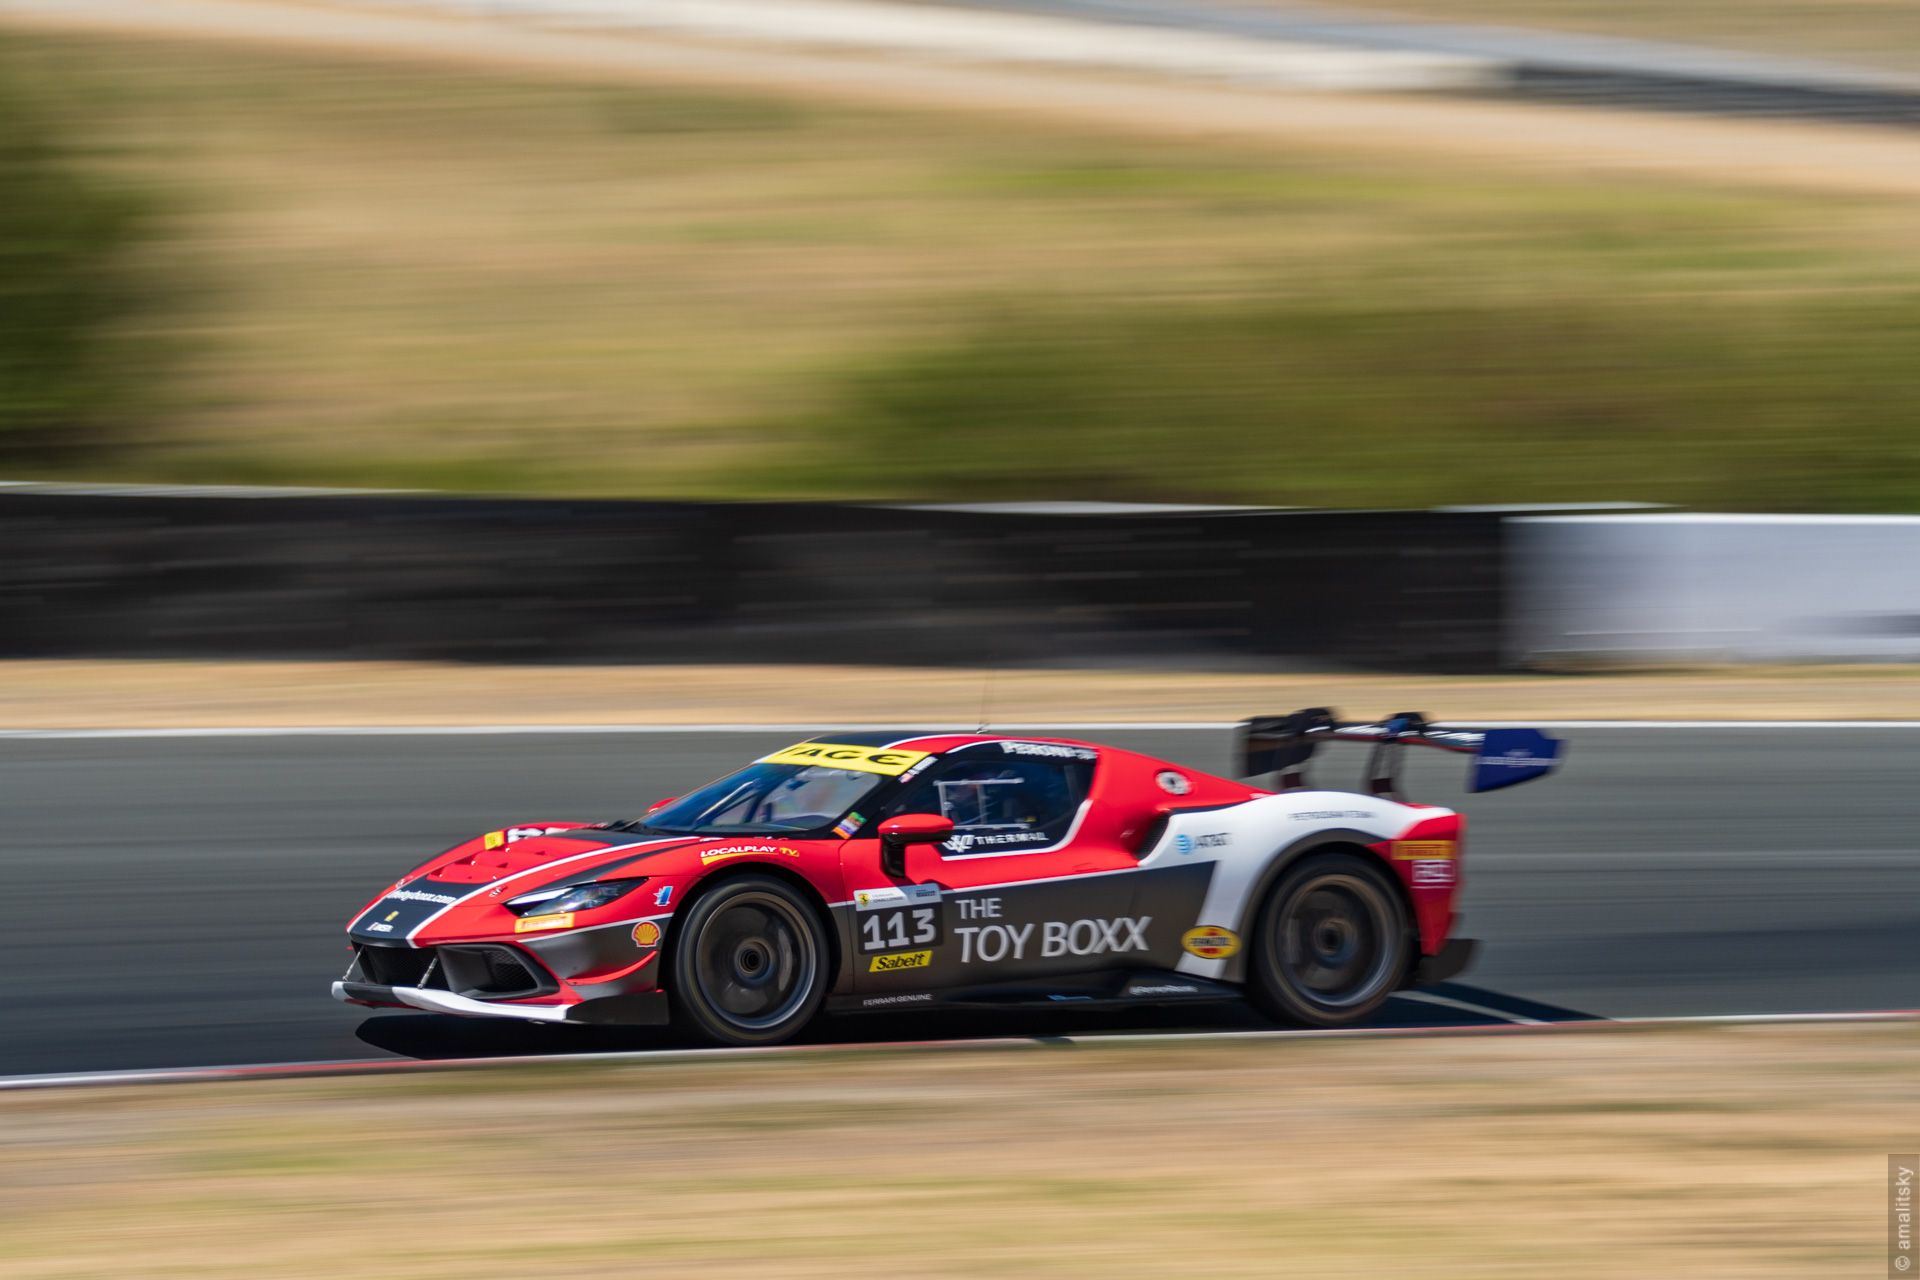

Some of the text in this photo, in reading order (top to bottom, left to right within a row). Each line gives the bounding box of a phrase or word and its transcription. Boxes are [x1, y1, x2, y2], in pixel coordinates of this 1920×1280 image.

[700, 845, 777, 858] LOCALPLAY
[955, 898, 1003, 919] THE
[863, 908, 937, 950] 113
[954, 916, 1153, 963] TOY BOXX
[876, 953, 925, 970] Sabelt
